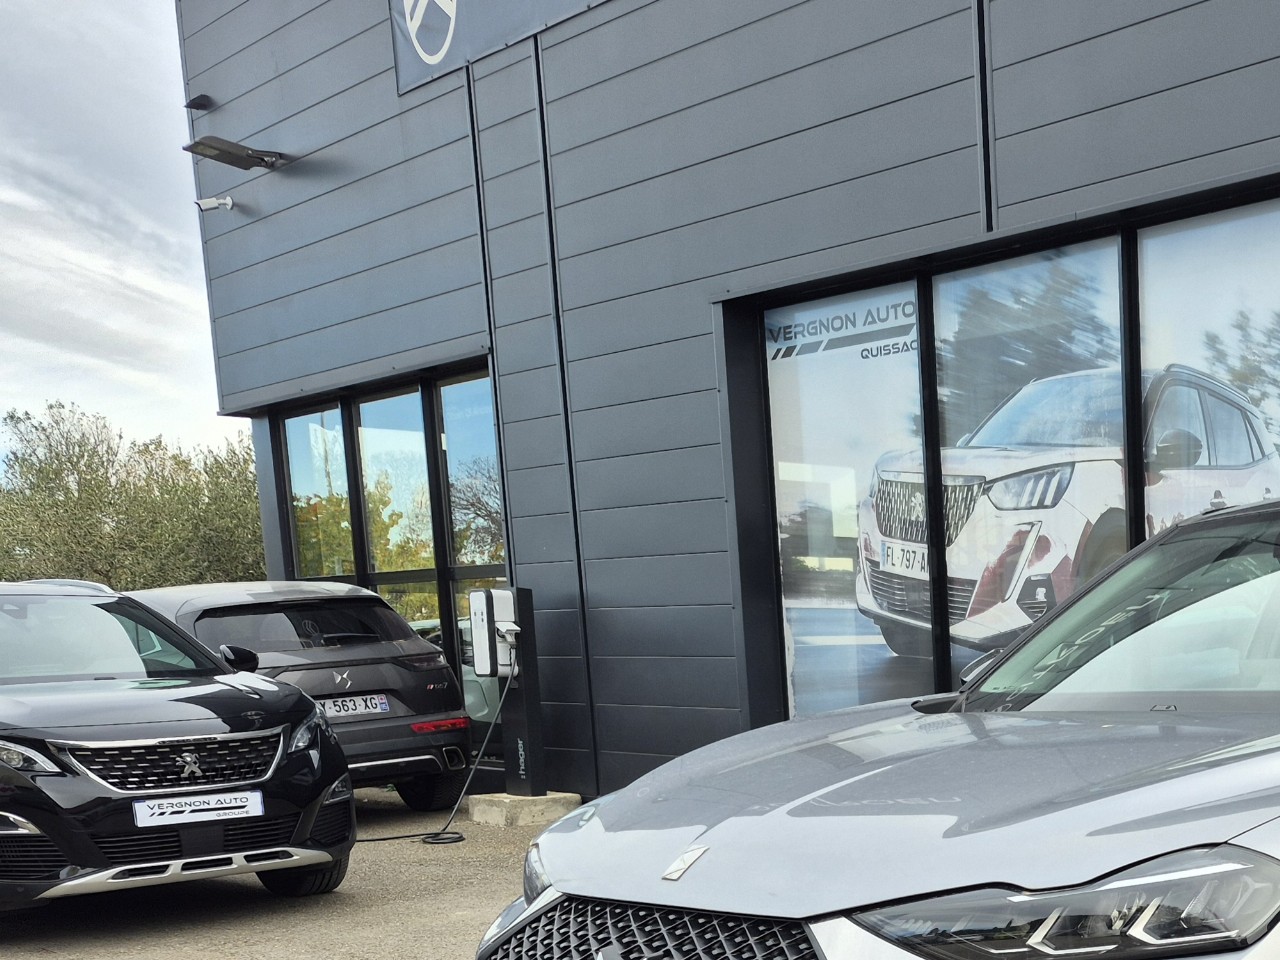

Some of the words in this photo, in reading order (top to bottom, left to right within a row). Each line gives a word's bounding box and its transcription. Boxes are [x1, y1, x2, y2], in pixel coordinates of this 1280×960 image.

[768, 311, 857, 344] VERGNON
[862, 300, 917, 327] AUTO
[885, 545, 929, 574] FL-797-A
[318, 696, 378, 714] Y-563-XG
[147, 799, 211, 811] VERGNON
[214, 796, 249, 806] AUTO
[216, 809, 250, 818] GROUPE
